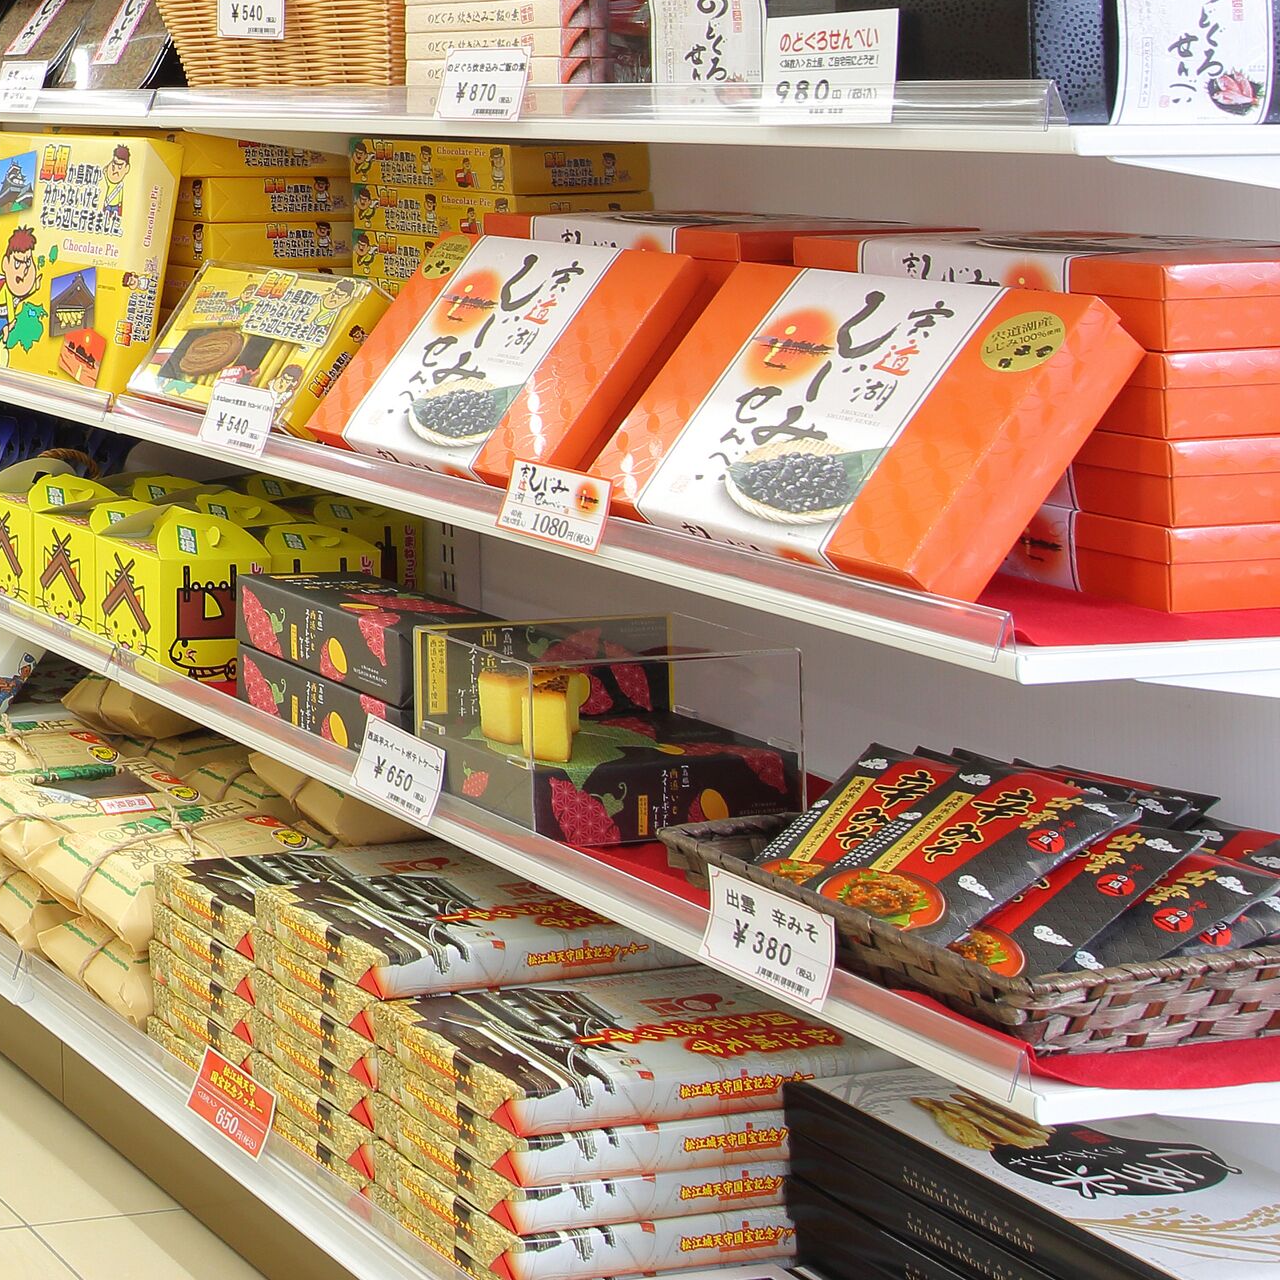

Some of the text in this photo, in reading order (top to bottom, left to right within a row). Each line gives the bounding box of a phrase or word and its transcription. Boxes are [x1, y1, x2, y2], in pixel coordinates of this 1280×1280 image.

[230, 3, 263, 23] ¥540
[778, 28, 879, 53] のどぐろせんべい
[447, 62, 526, 72] のどぐろ炊き込みご飯の素
[455, 81, 497, 103] ¥870
[436, 146, 487, 157] Chocolate Pie
[40, 144, 103, 185] 島根か鳥取か
[43, 185, 100, 206] 分からないけど
[62, 239, 119, 258] Chocolate Pie
[254, 270, 320, 305] 島根か鳥取か
[216, 412, 249, 435] ¥540
[368, 730, 441, 775] 西浜芋スイートポテトケーキ
[374, 755, 414, 793] ¥650
[725, 888, 819, 944] 出雲 辛みそ
[527, 942, 649, 967] 松江城天守国宝記念クッキー
[732, 918, 793, 968] ¥380
